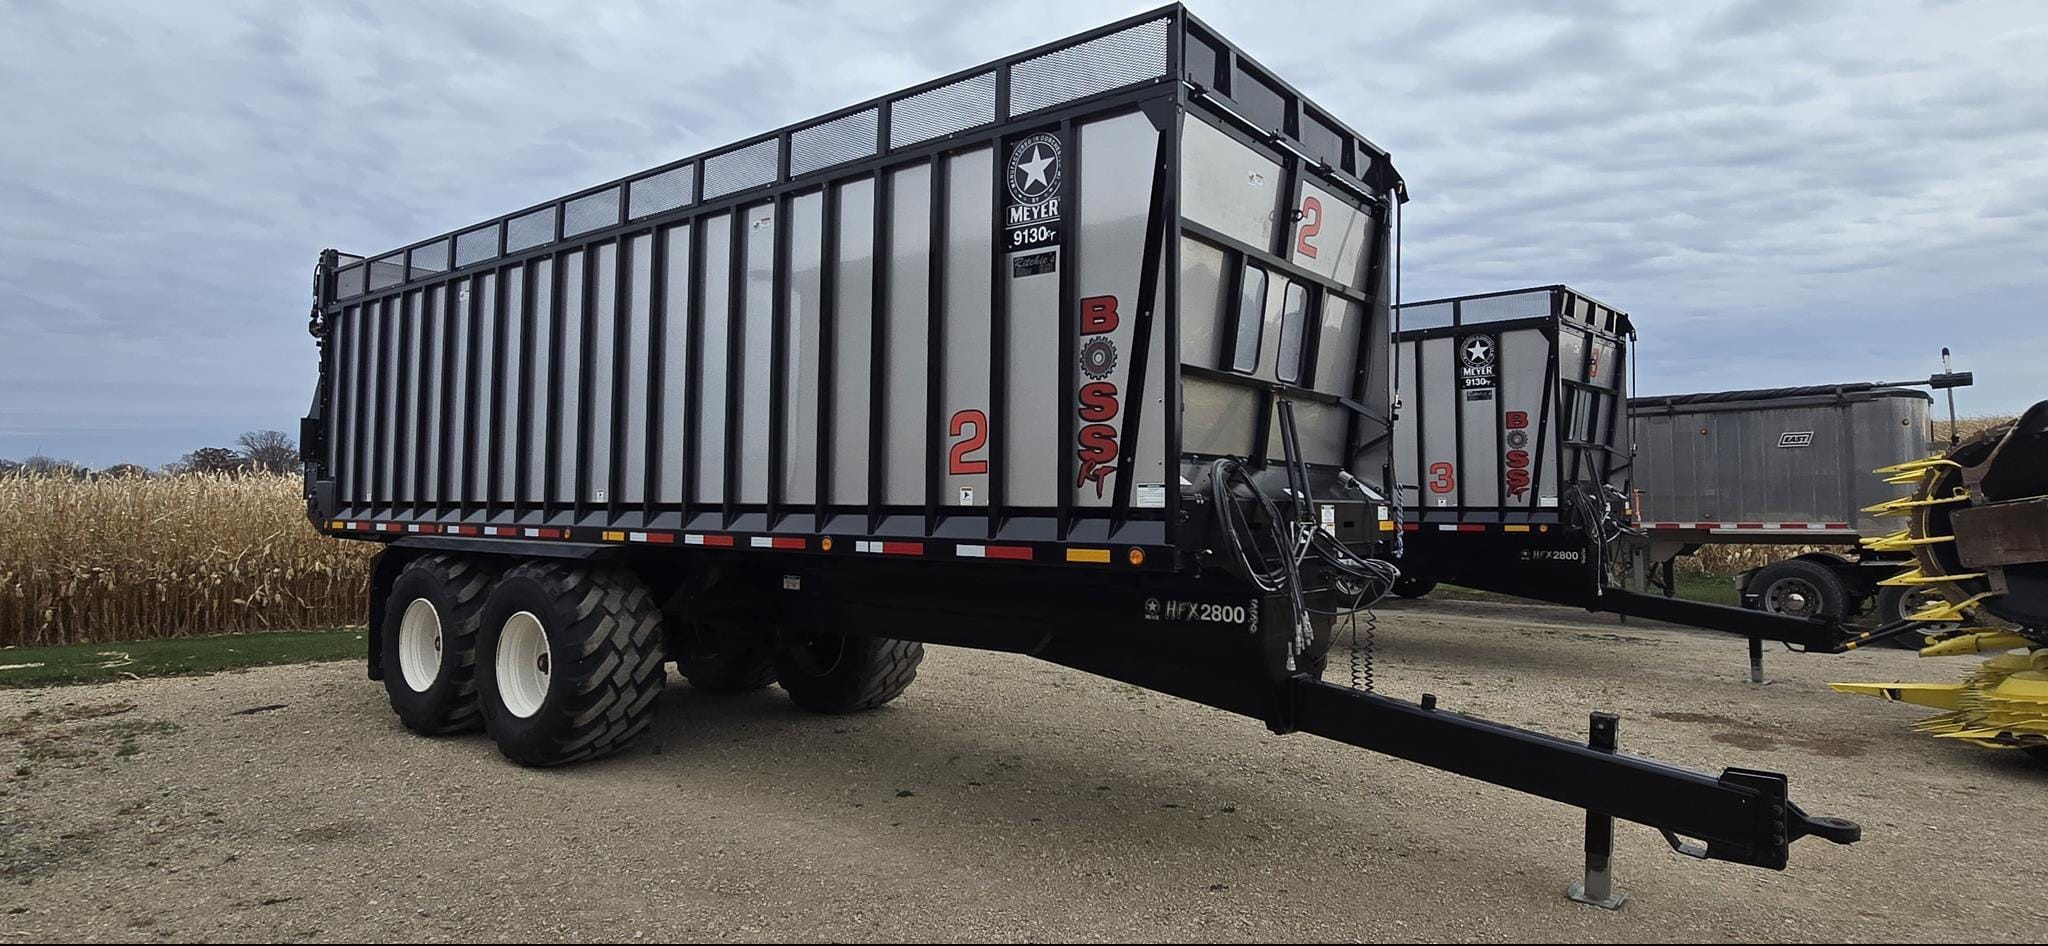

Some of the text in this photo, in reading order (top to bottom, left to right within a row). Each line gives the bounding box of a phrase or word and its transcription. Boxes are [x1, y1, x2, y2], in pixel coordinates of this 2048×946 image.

[1010, 199, 1058, 223] MEYER
[1297, 196, 1322, 259] 2
[1464, 367, 1493, 376] MEYER
[950, 409, 987, 475] 2
[1429, 461, 1455, 493] 3
[1166, 600, 1245, 623] HFX2800
